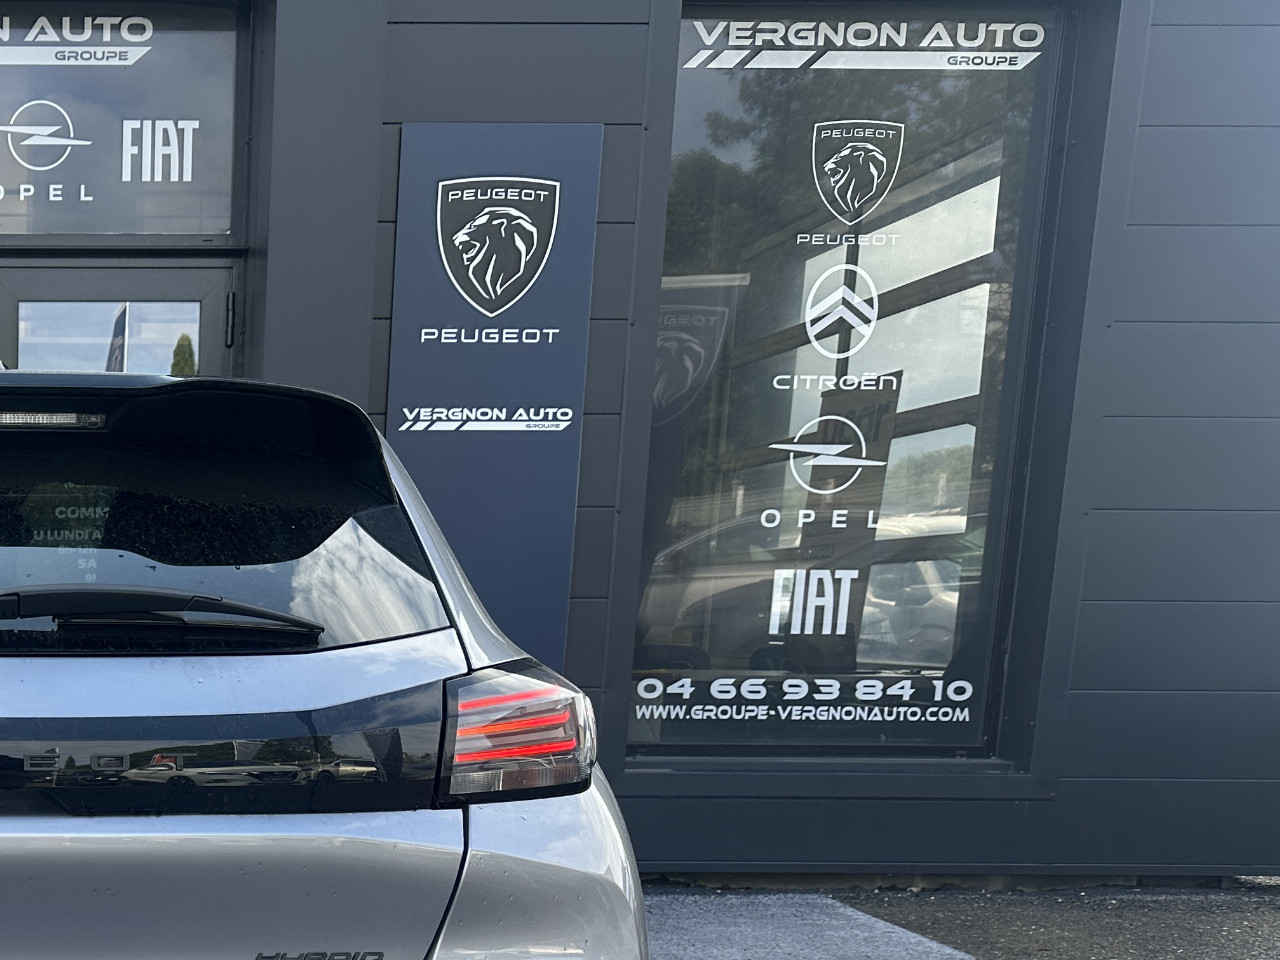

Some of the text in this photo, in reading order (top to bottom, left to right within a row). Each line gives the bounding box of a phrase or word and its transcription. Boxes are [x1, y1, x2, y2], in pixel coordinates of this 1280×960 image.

[23, 16, 154, 43] AUTO
[692, 20, 1046, 48] VERGNON AUTO
[54, 50, 129, 61] GROUPE
[946, 55, 1019, 66] GROUPE
[821, 128, 897, 140] PEUGEOT
[121, 119, 200, 182] FIAT
[448, 188, 550, 202] PEUGEOT
[796, 233, 902, 246] PEUGEOT
[420, 328, 561, 344] PEUGEOT
[402, 407, 573, 421] VERGNON AUTO
[760, 508, 880, 529] OPEL
[768, 569, 859, 635] FIAT
[636, 678, 975, 702] 04 66 93 84 10
[635, 704, 971, 722] WWW.GROUPE-VERGNONAUTO.COM
